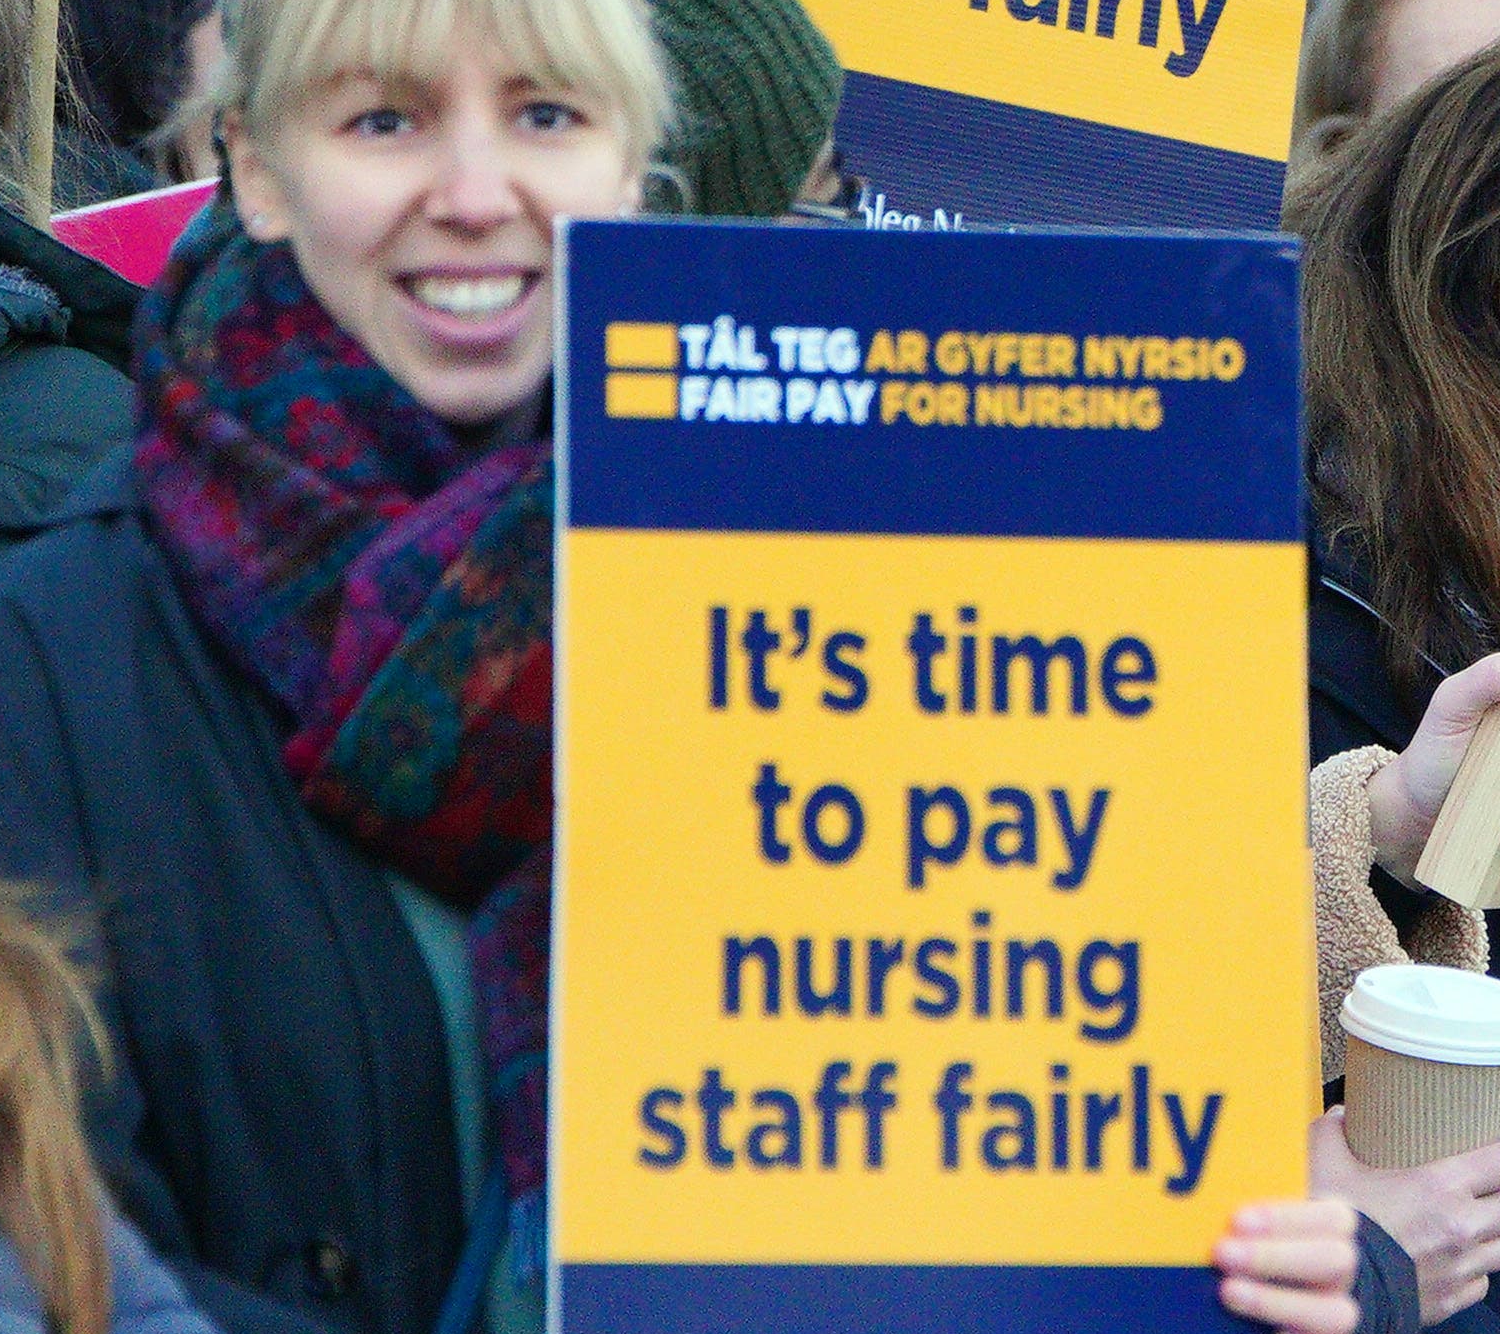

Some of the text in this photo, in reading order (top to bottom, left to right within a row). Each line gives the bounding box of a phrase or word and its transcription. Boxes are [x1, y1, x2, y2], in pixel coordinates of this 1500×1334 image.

[678, 316, 1245, 381] TÂL TEG AR GYFER NYRSIO
[678, 377, 1162, 430] FAIR PAY FOR NURSING
[908, 605, 1157, 718] time
[752, 763, 1110, 891] to pay
[722, 910, 1140, 1044] nursing
[639, 1060, 1223, 1196] staff fairly
